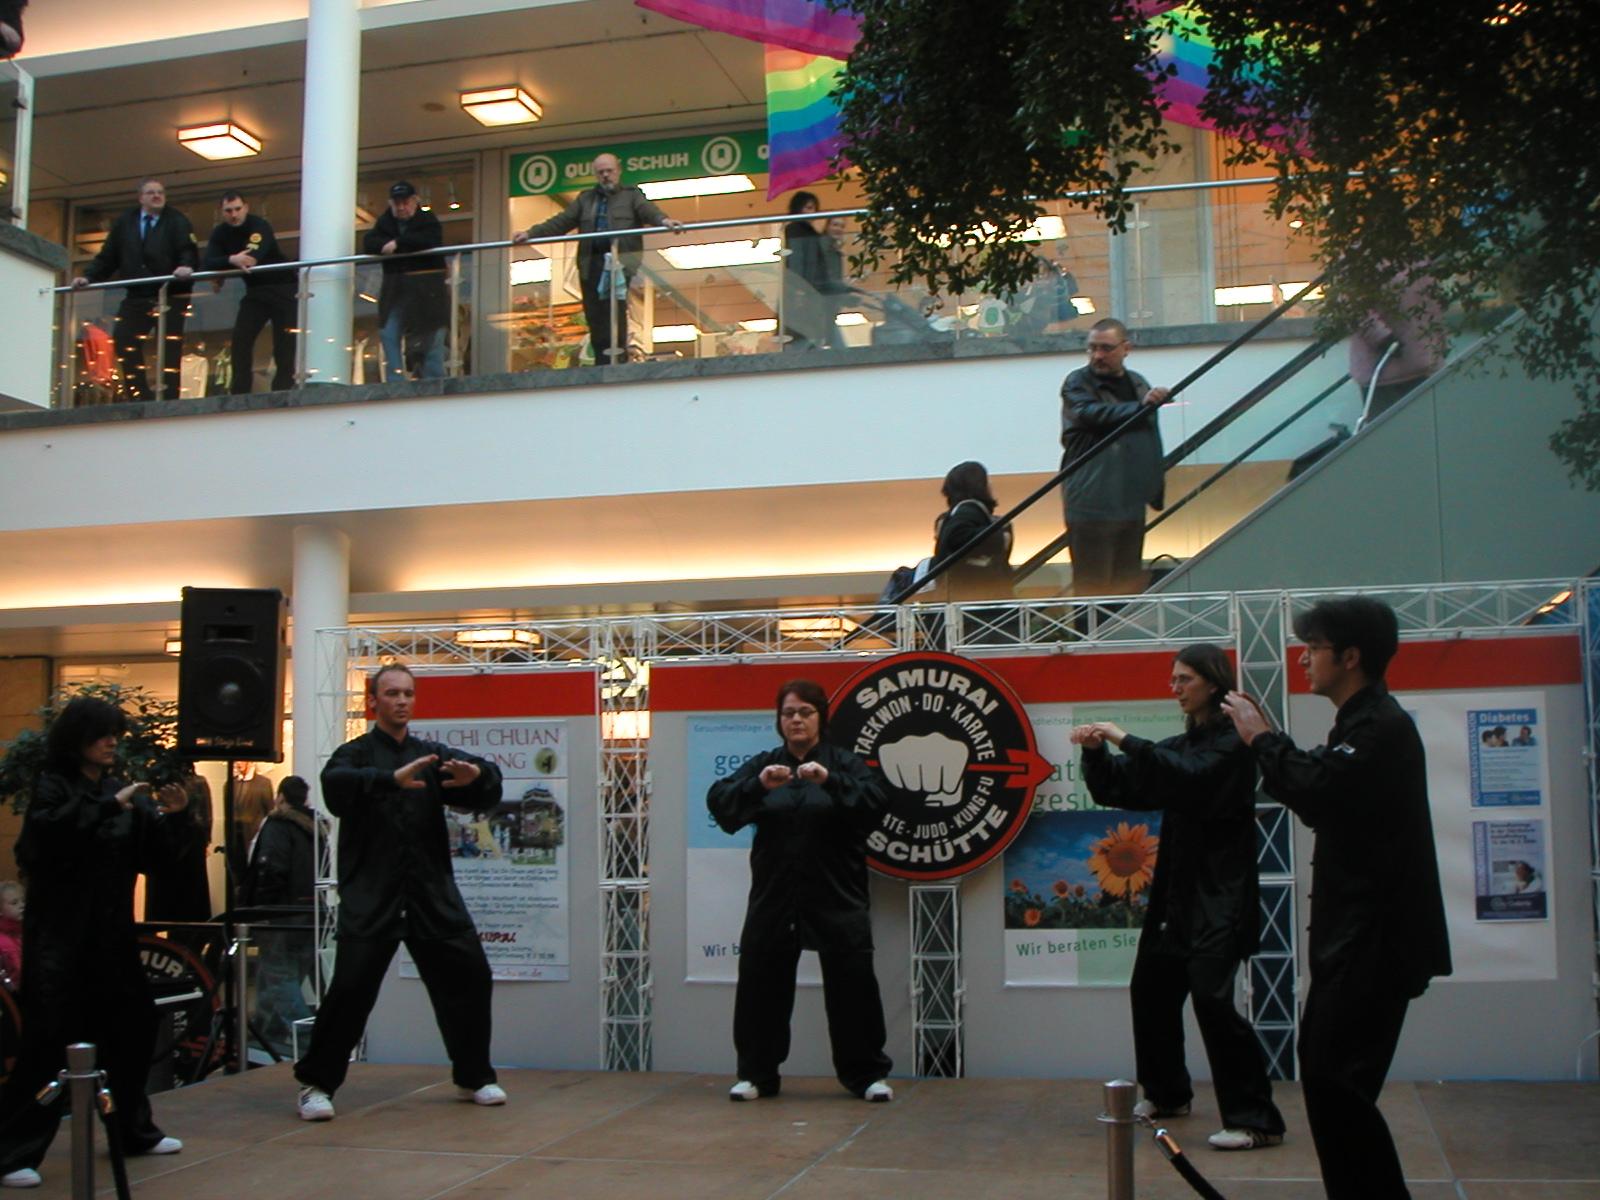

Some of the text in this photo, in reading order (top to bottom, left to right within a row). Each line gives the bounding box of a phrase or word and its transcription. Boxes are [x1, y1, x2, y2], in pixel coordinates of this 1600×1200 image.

[627, 152, 689, 172] SCHUH
[855, 668, 1000, 716] SAMURAI
[854, 692, 996, 762] TAEKWON DO KARATE
[1480, 711, 1530, 724] Diabetes
[447, 729, 480, 746] CHI
[486, 728, 560, 746] CHUAN
[913, 821, 949, 839] JUDO
[952, 795, 987, 829] KUNG
[976, 775, 995, 796] FU
[866, 803, 1009, 863] SCHÜTTE
[703, 943, 727, 957] Wir
[1016, 933, 1137, 957] Wir beraten Sie
